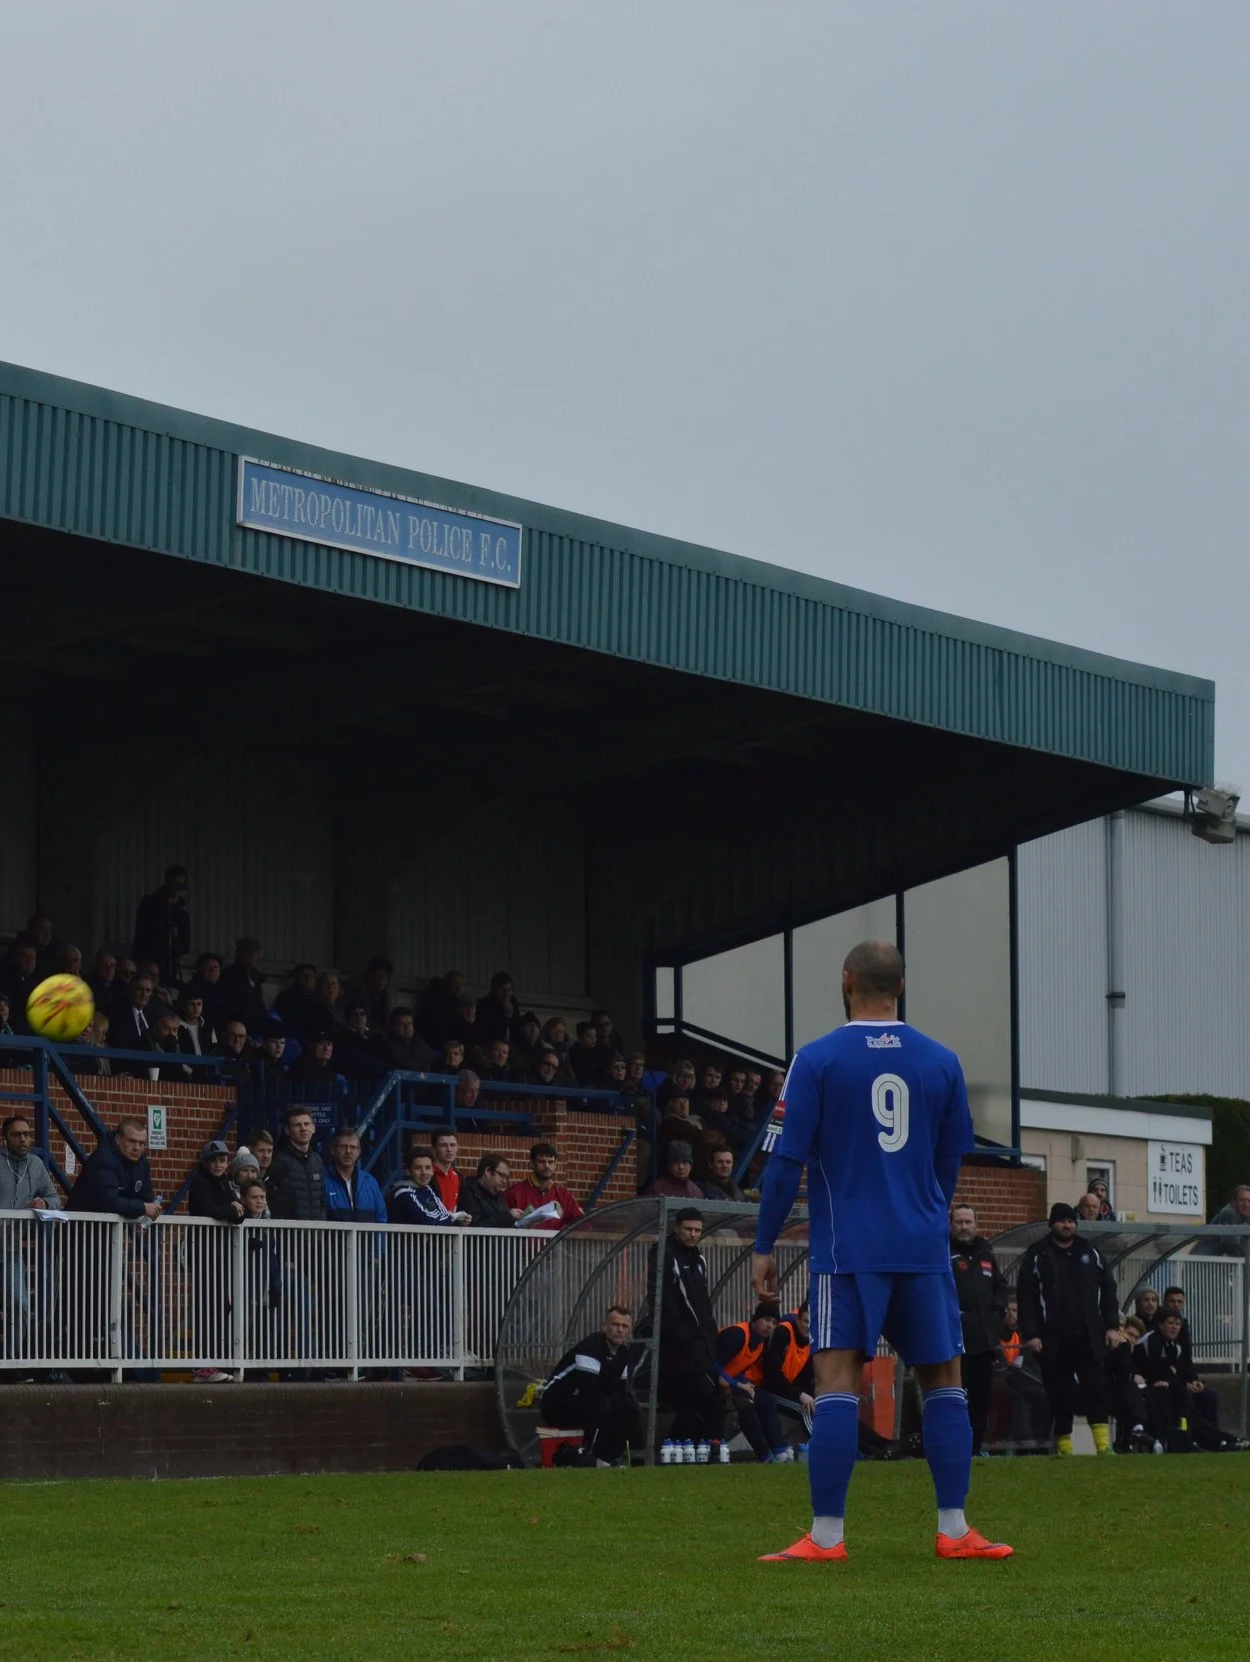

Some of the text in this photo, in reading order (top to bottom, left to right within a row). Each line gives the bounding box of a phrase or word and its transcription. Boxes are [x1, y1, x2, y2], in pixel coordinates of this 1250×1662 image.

[250, 476, 512, 572] METROPOLITAN POLICE F.C.
[871, 1072, 910, 1153] 9
[1169, 1150, 1193, 1174] TEAS
[1164, 1183, 1199, 1206] TOILETS
